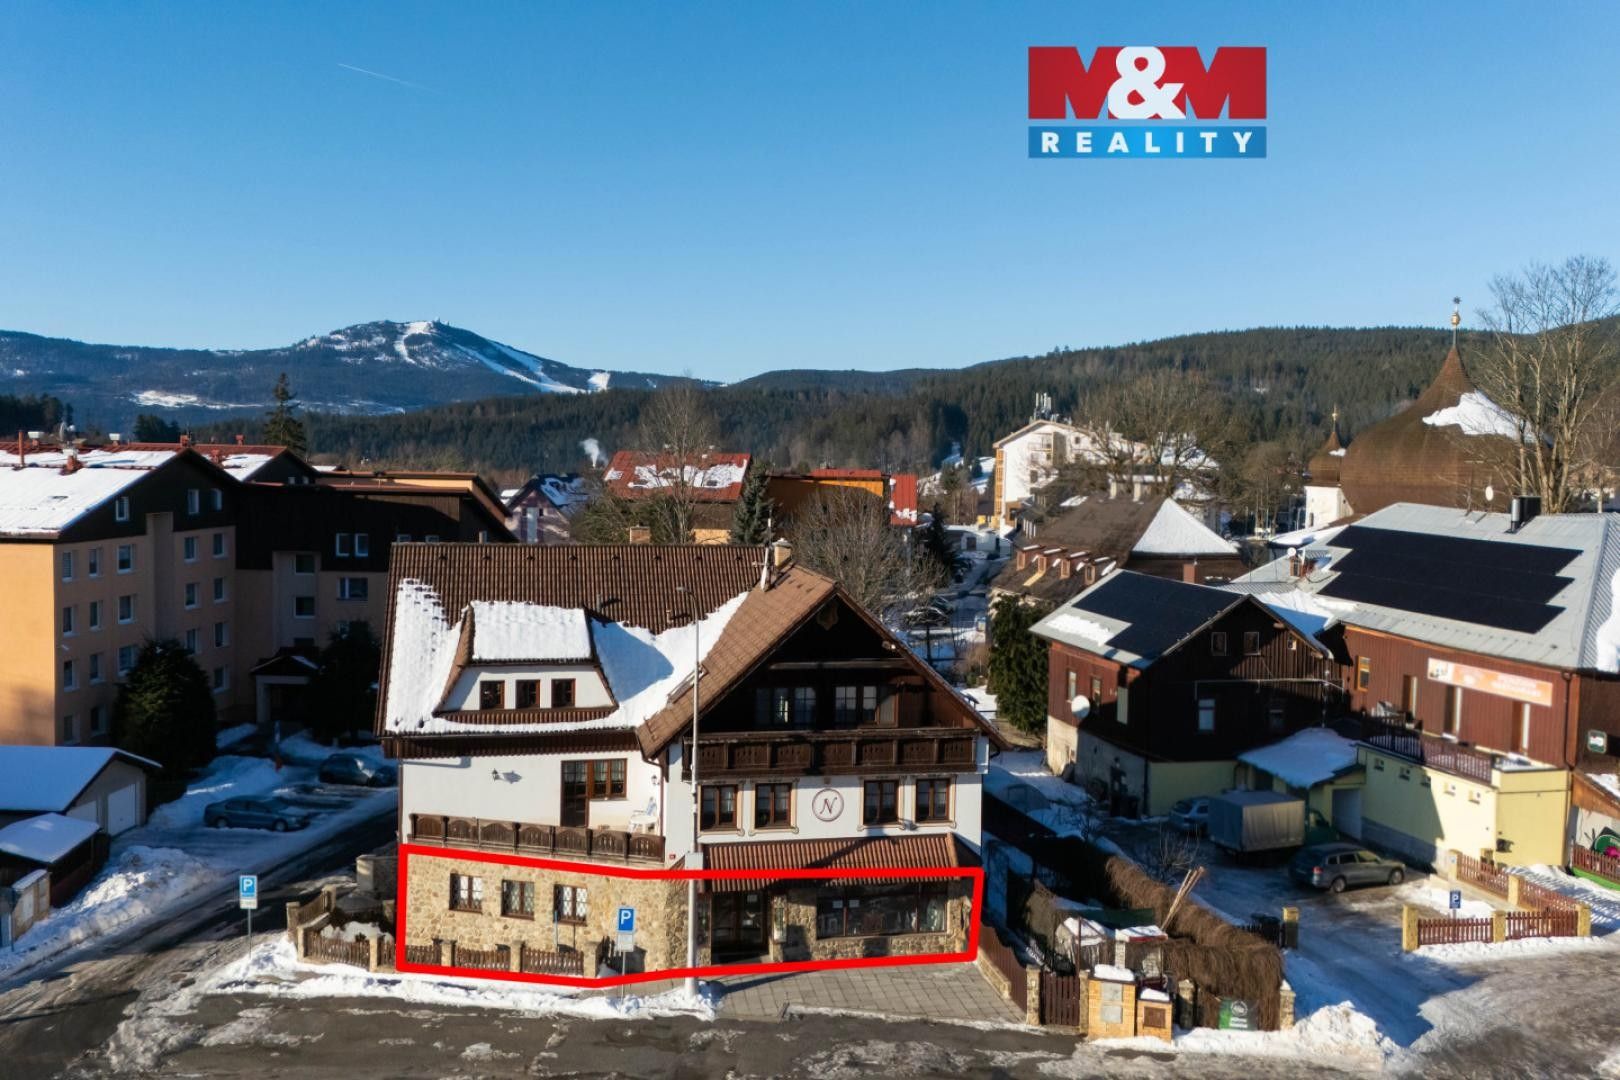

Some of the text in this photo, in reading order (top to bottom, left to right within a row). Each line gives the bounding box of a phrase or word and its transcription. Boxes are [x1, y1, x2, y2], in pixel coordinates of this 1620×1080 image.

[820, 796, 838, 814] N
[243, 879, 253, 892] P
[621, 910, 631, 925] P
